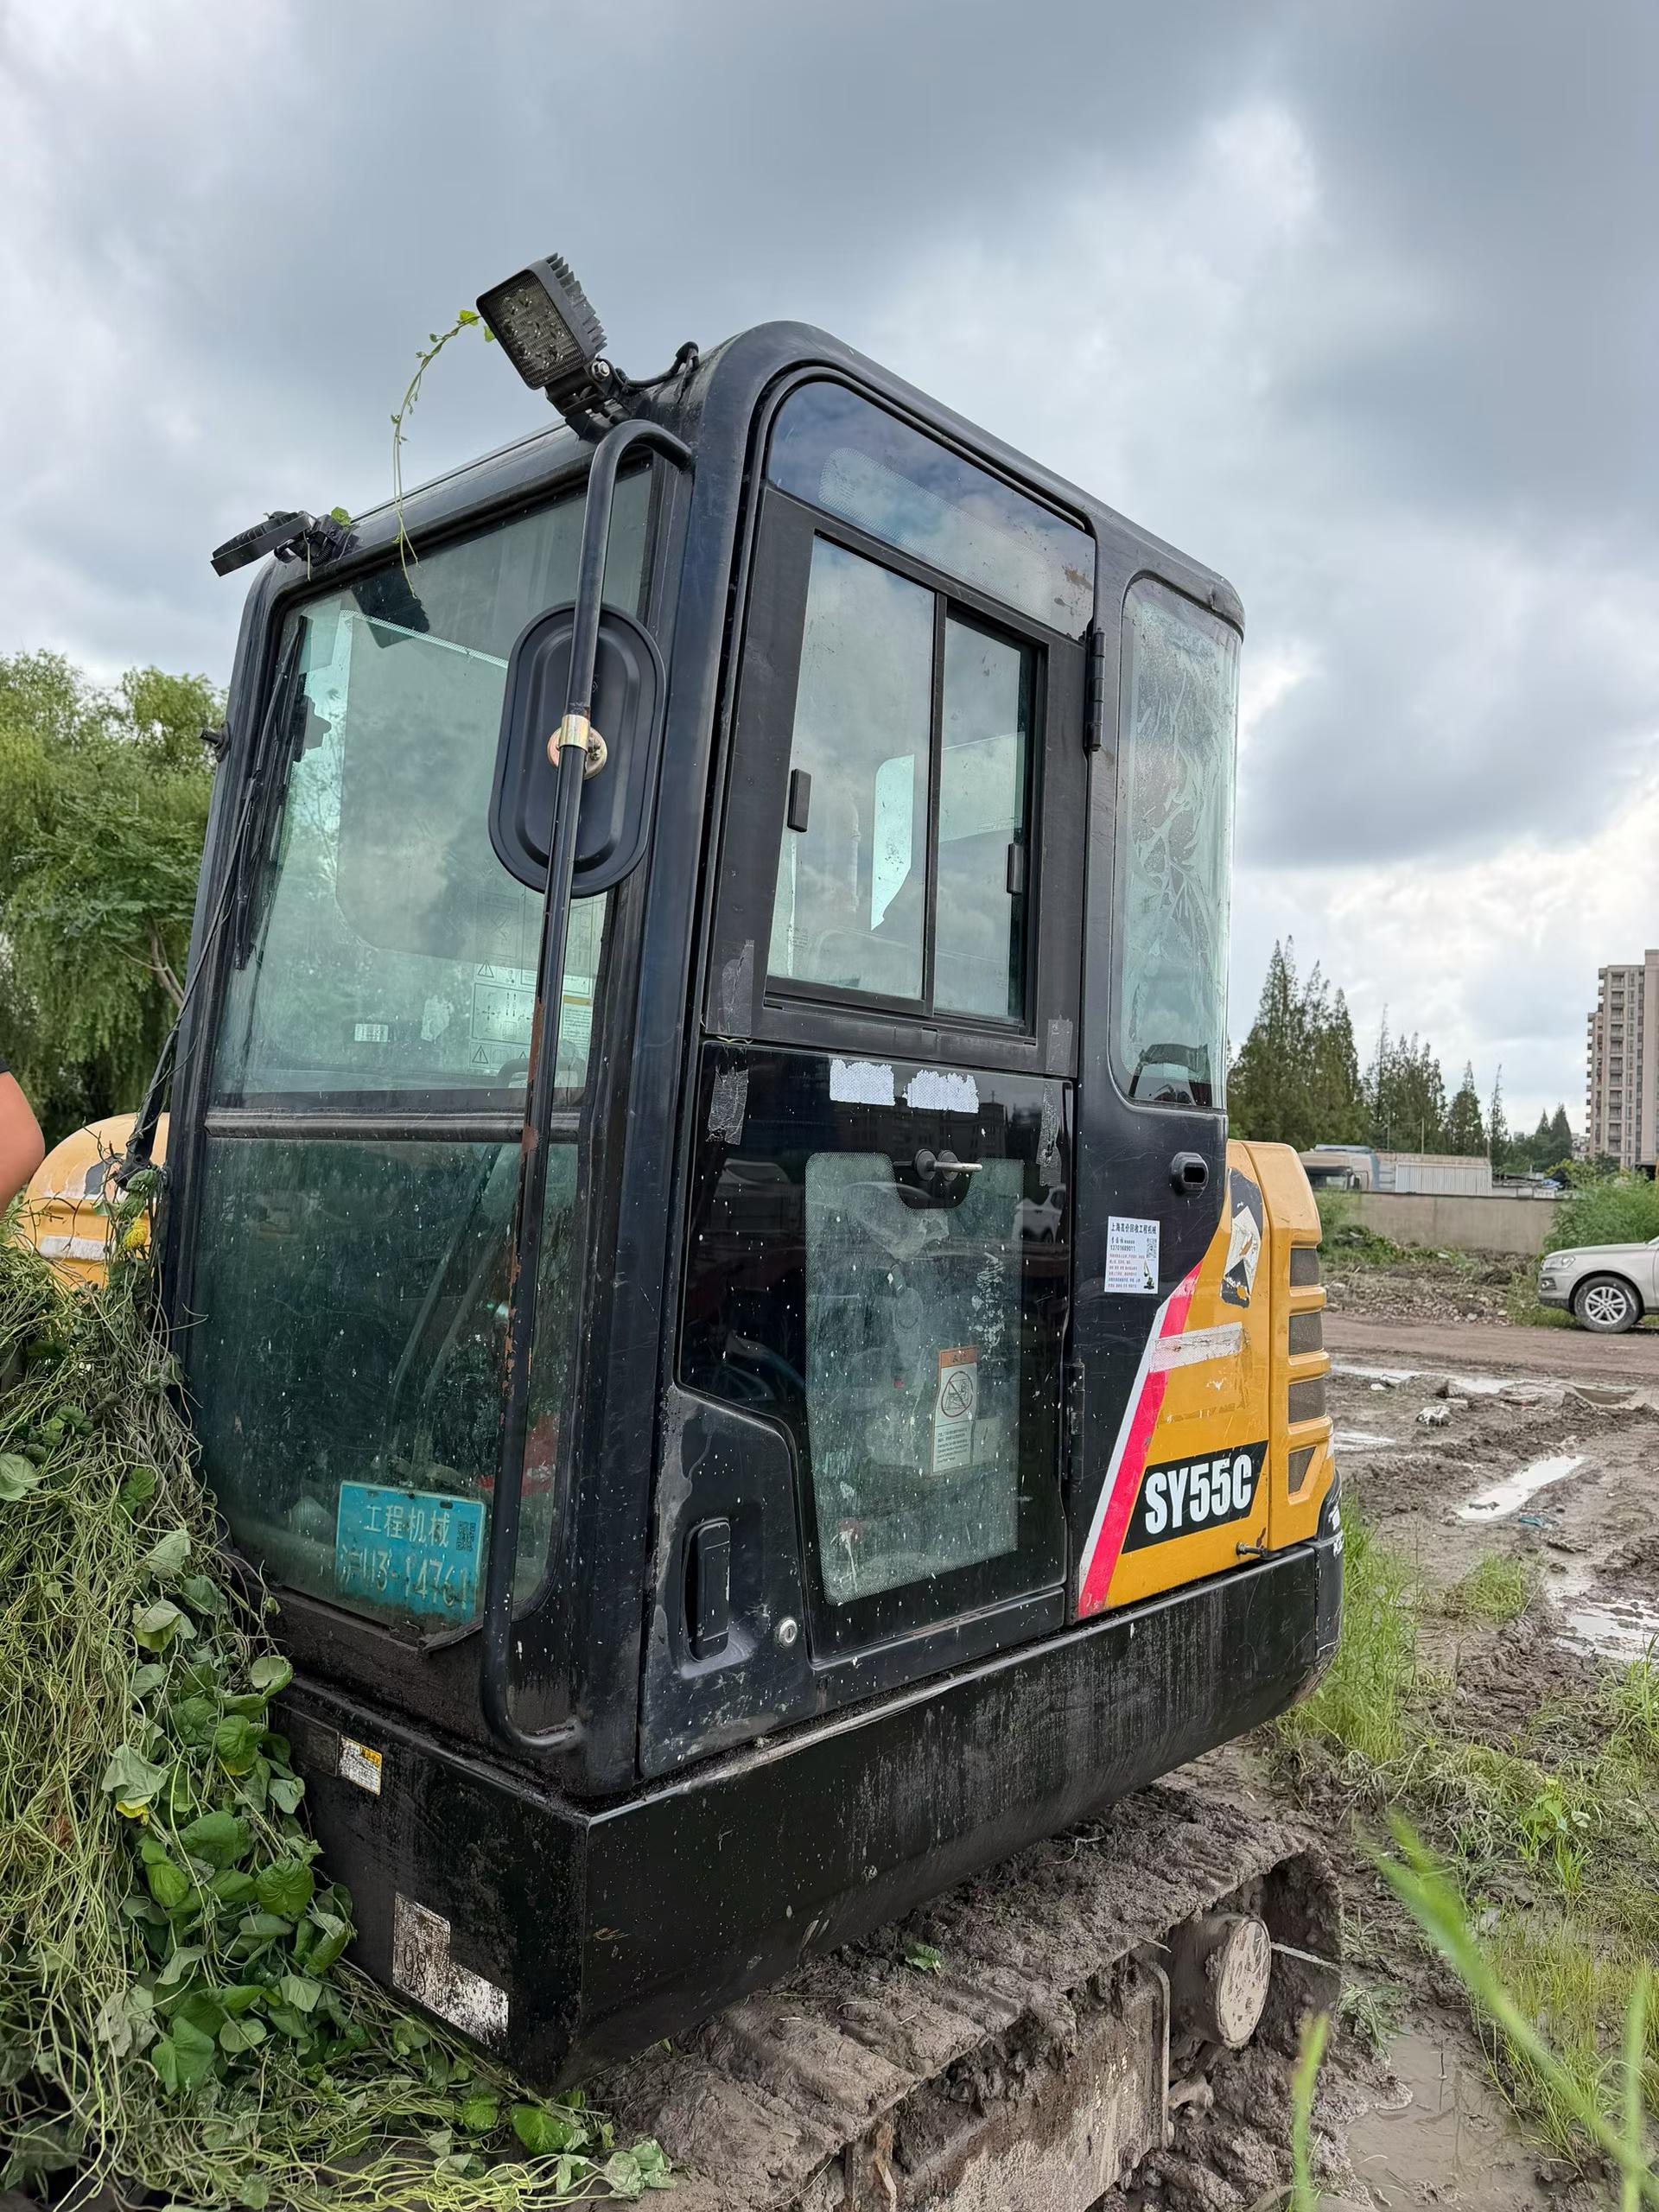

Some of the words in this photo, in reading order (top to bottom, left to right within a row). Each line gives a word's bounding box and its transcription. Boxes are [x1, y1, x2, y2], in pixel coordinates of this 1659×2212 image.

[1145, 1454, 1252, 1535] SY55C
[364, 1504, 451, 1548] 工程机械
